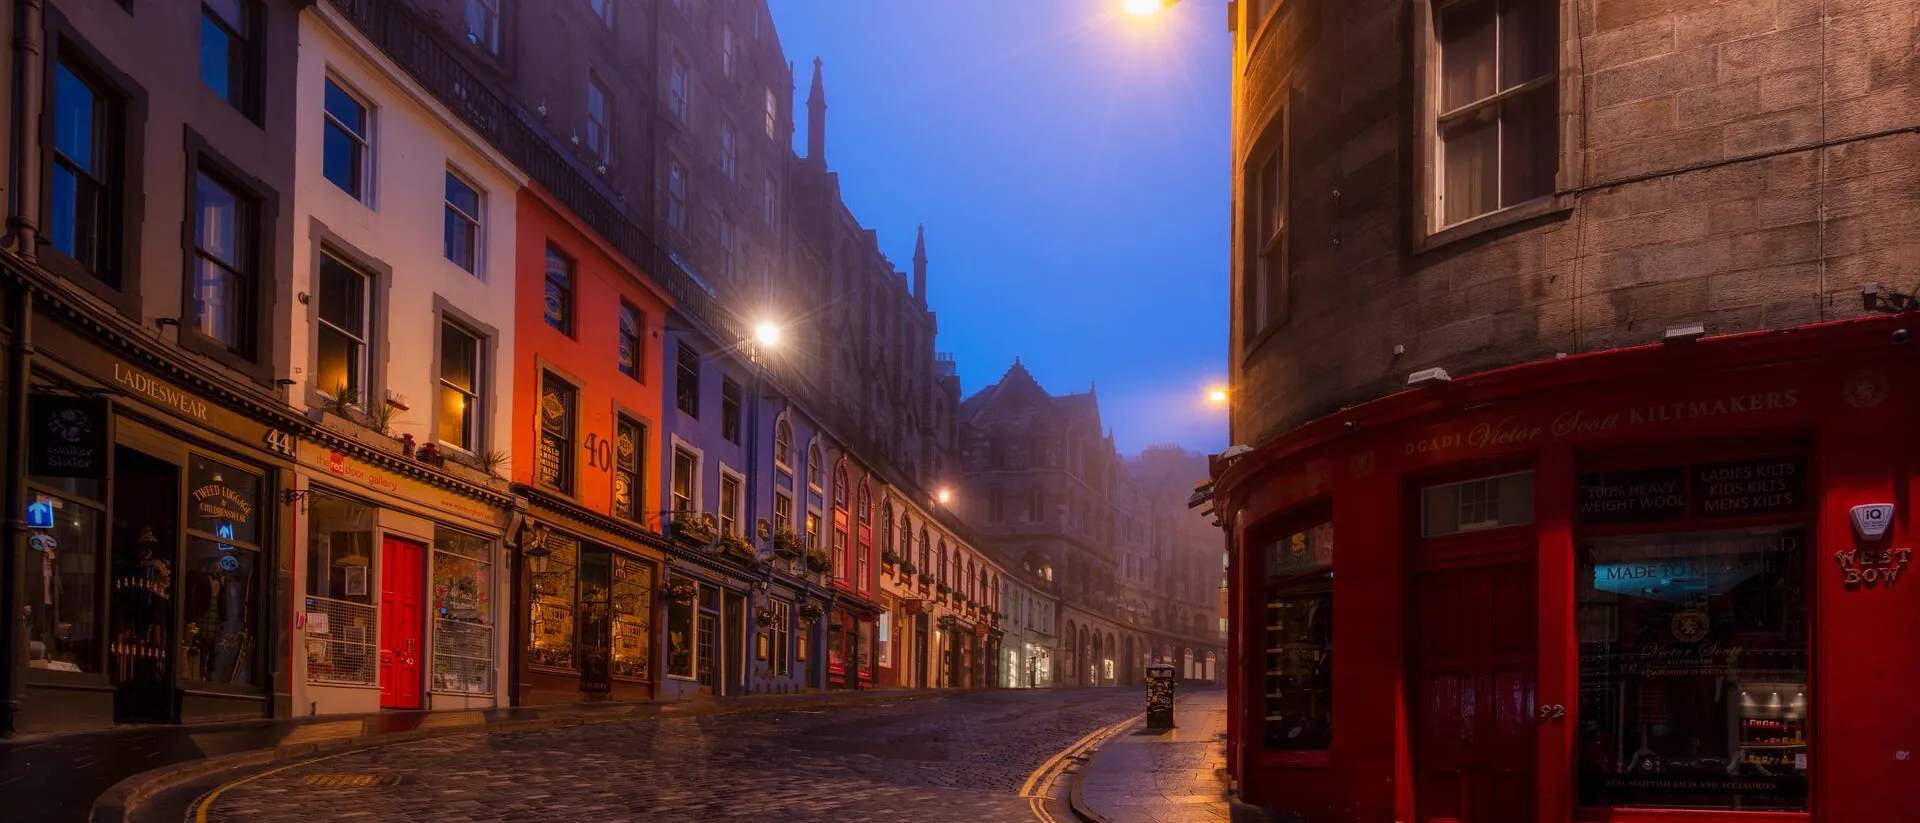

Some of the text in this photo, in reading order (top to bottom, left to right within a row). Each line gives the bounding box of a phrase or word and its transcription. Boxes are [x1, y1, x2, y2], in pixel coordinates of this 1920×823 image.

[114, 363, 207, 420] LADIESWEAR
[1467, 415, 1542, 447] Victor
[1551, 408, 1620, 437] Scott
[1630, 389, 1799, 424] KILTMAKERS
[584, 432, 611, 472] 40
[316, 455, 398, 491] the red door gallery
[1701, 462, 1796, 482] LADIES KILTS
[1587, 480, 1676, 499] 100% HEAVY
[1709, 478, 1786, 497] KIDS KILTS
[193, 484, 254, 517] TWEED LUGGAGE
[1580, 494, 1685, 513] WEIGHT WOOL
[1703, 492, 1793, 512] MENS KILTS
[200, 502, 248, 523] CHILDRENSWEAR
[1866, 509, 1881, 520] iQ
[1835, 548, 1910, 568] WEST
[1606, 565, 1657, 580] MADE
[1661, 563, 1686, 577] TO
[1844, 567, 1899, 585] BOW
[1540, 704, 1565, 718] 92
